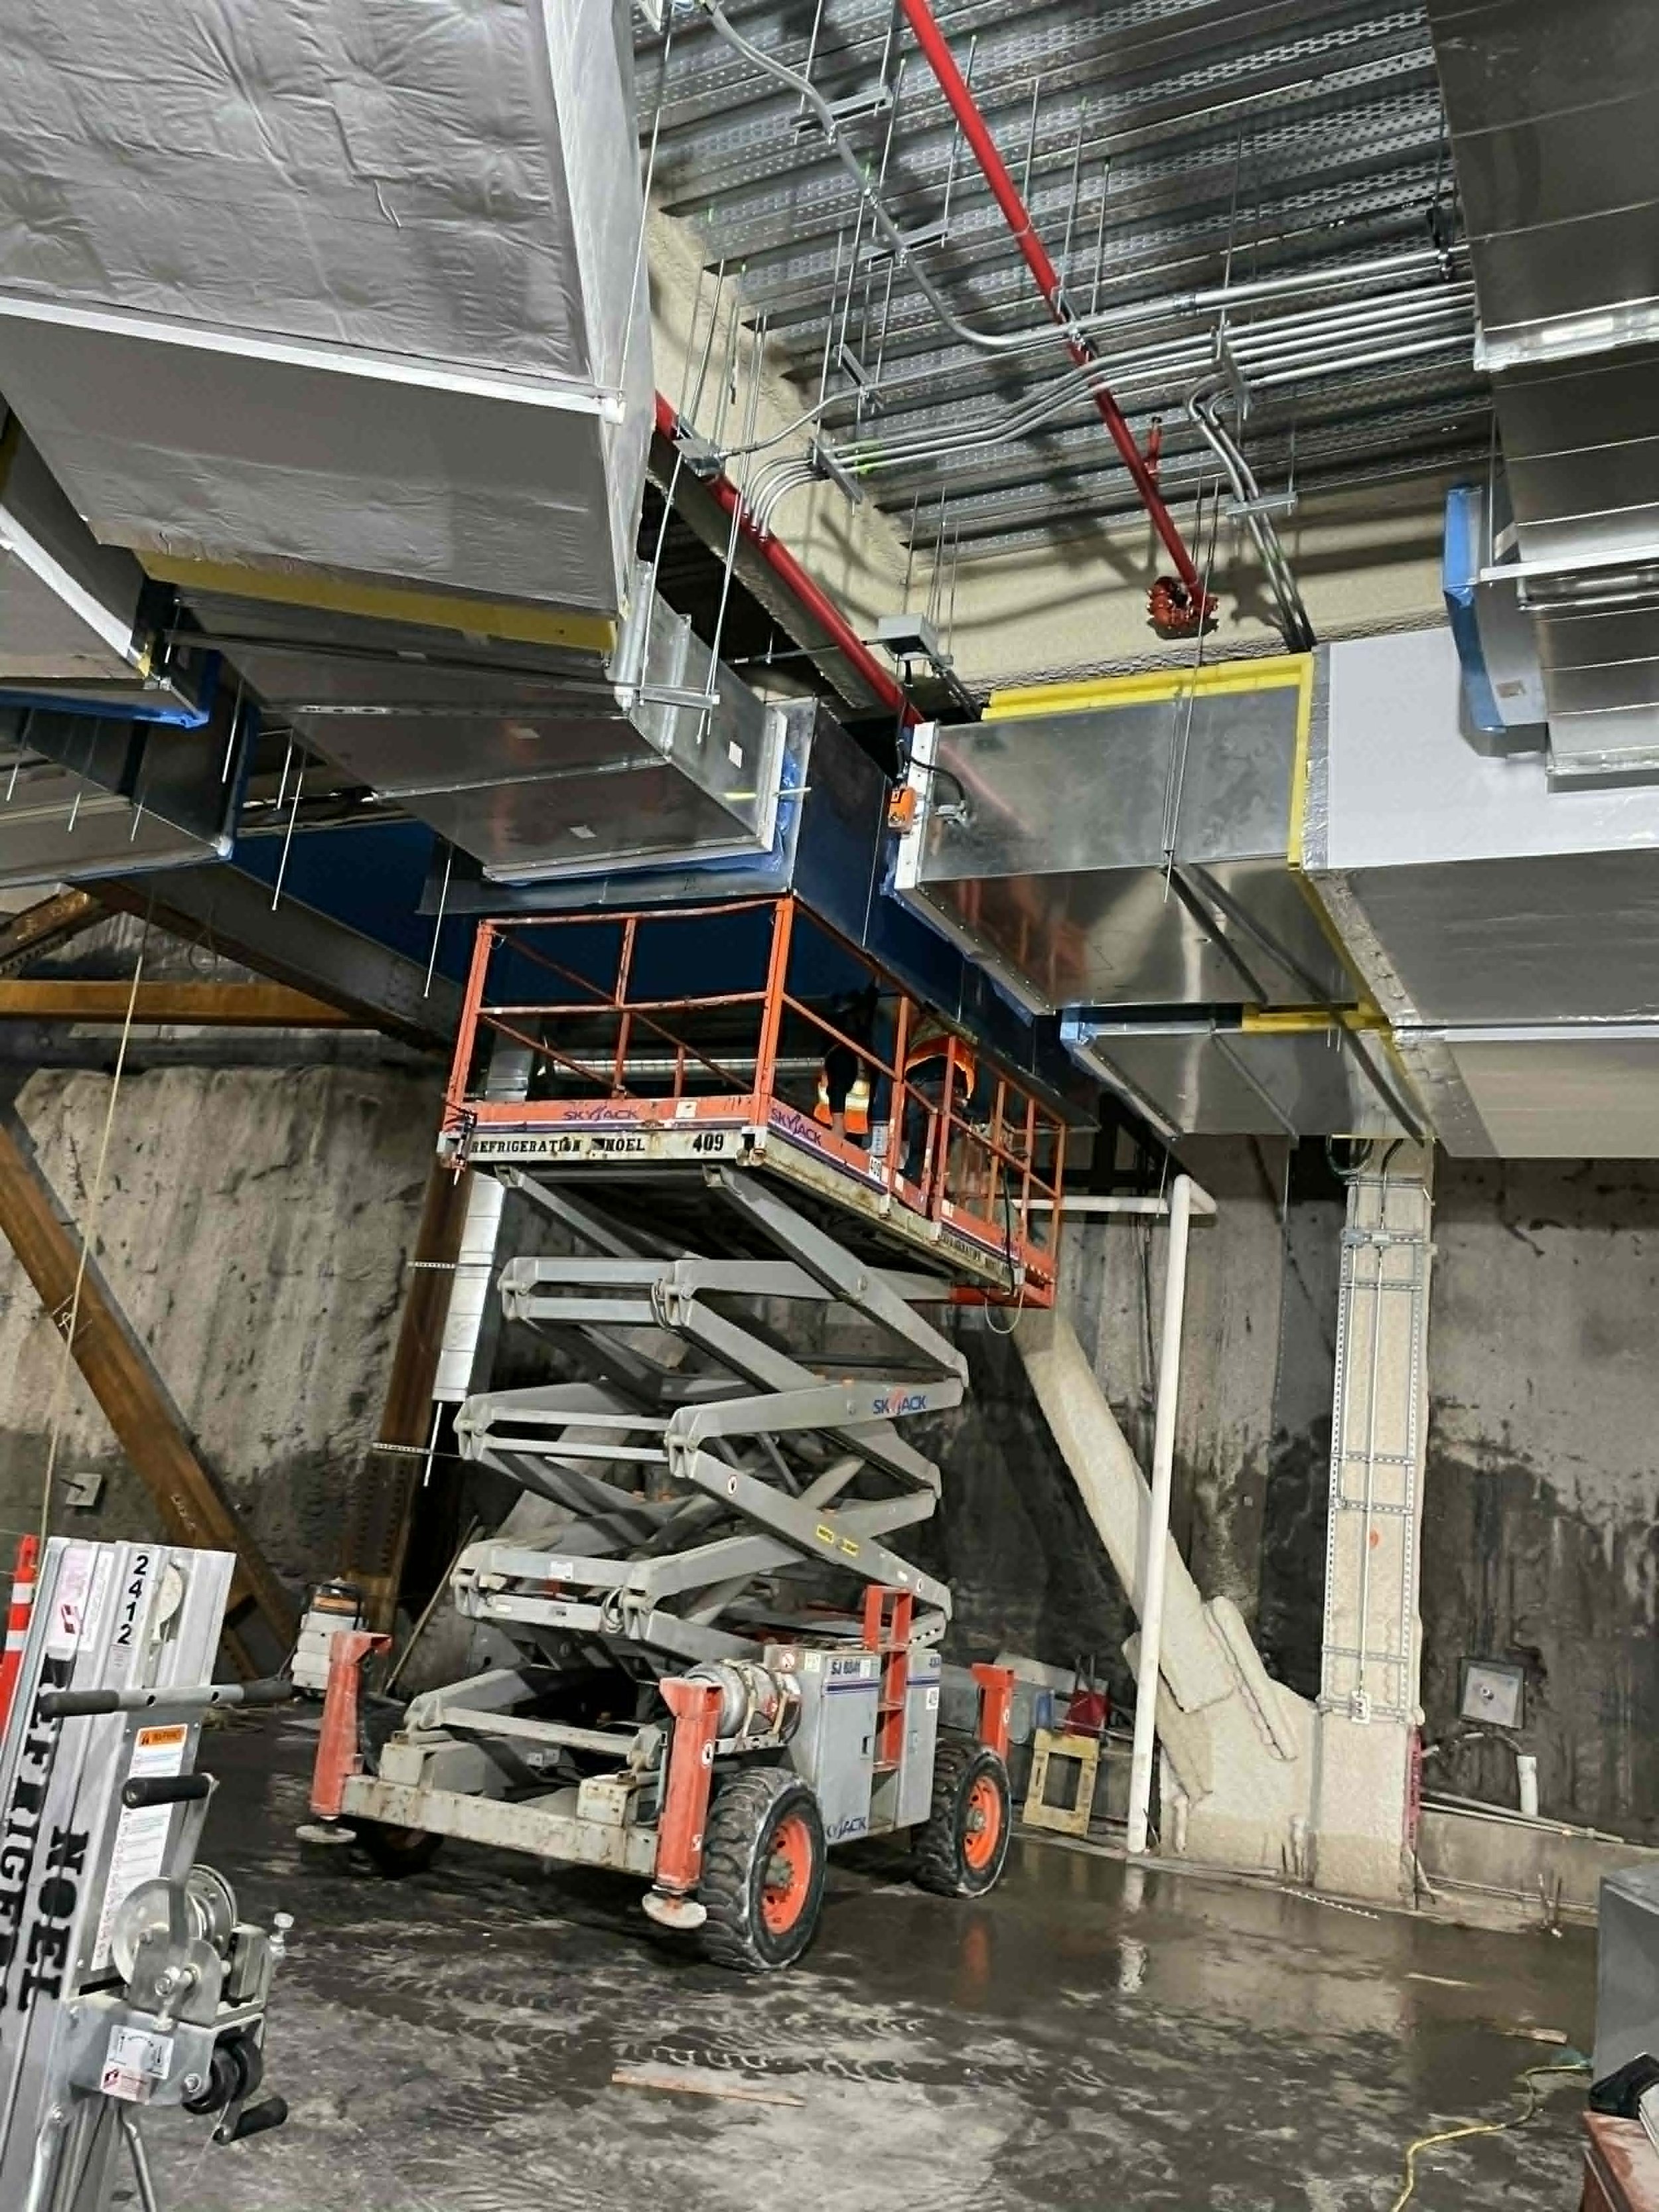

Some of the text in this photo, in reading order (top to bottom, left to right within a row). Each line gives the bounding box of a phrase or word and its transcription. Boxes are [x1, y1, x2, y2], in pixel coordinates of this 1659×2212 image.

[605, 1138, 645, 1151] NOEL
[693, 1133, 724, 1152] 409
[18, 1826, 90, 2012] NOEL
